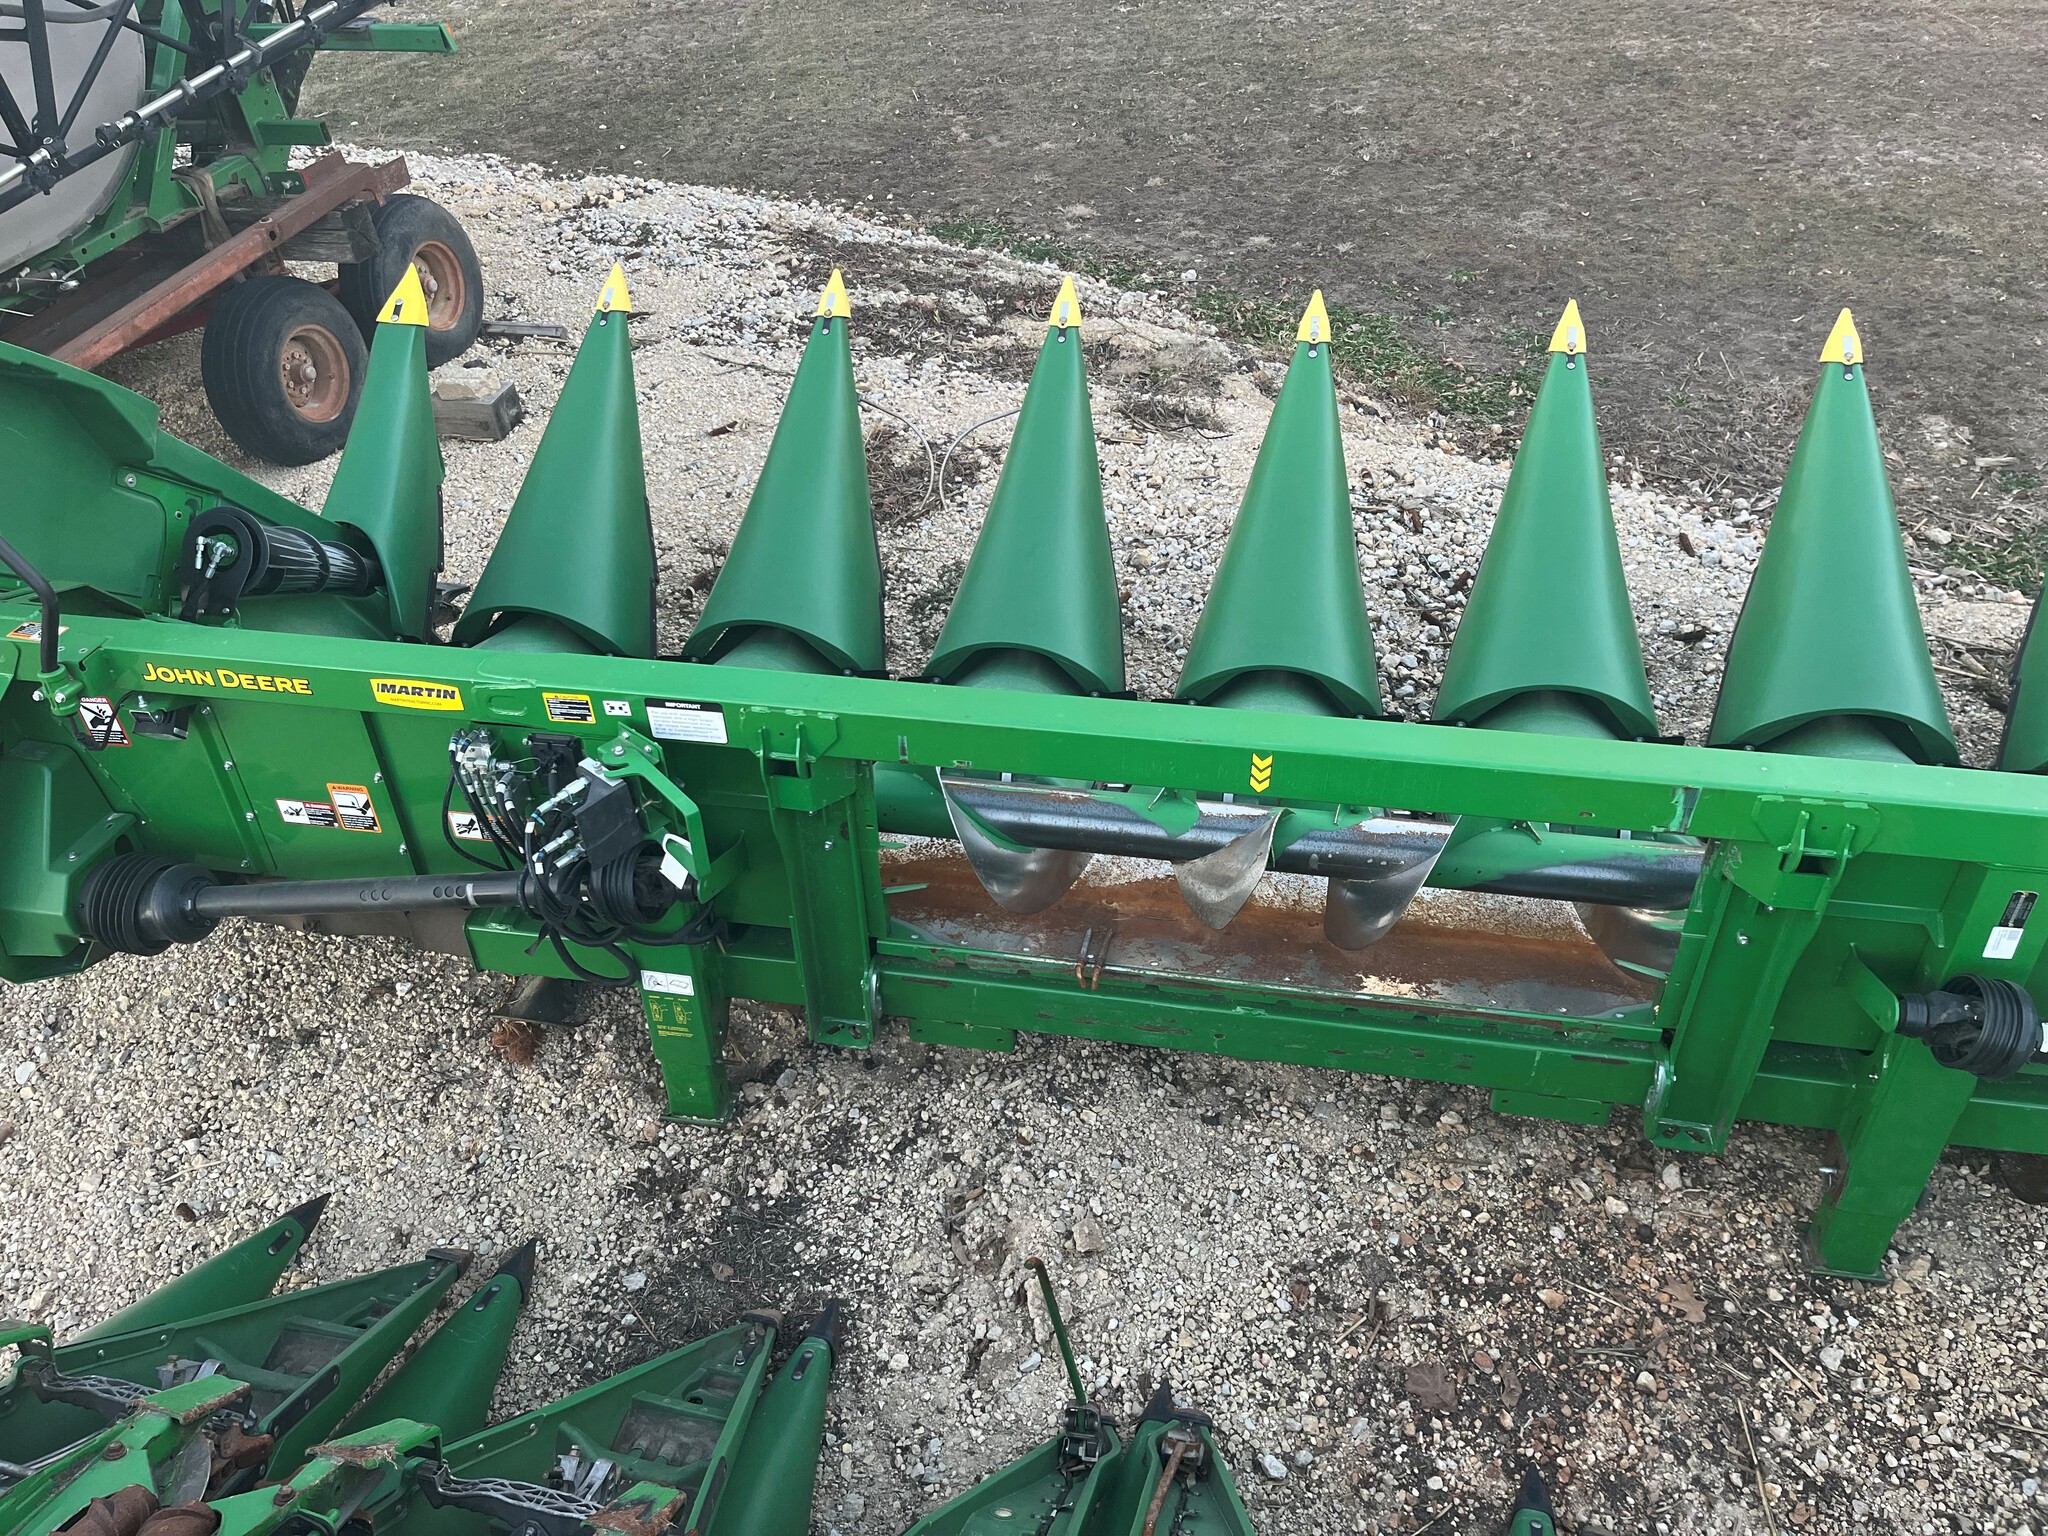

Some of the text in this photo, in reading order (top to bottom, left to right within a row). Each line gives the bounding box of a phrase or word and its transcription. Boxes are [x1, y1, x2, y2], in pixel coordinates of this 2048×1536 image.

[142, 661, 313, 695] JOHN DEERE
[380, 683, 456, 700] MARTIN
[664, 701, 702, 710] IMPORTANT
